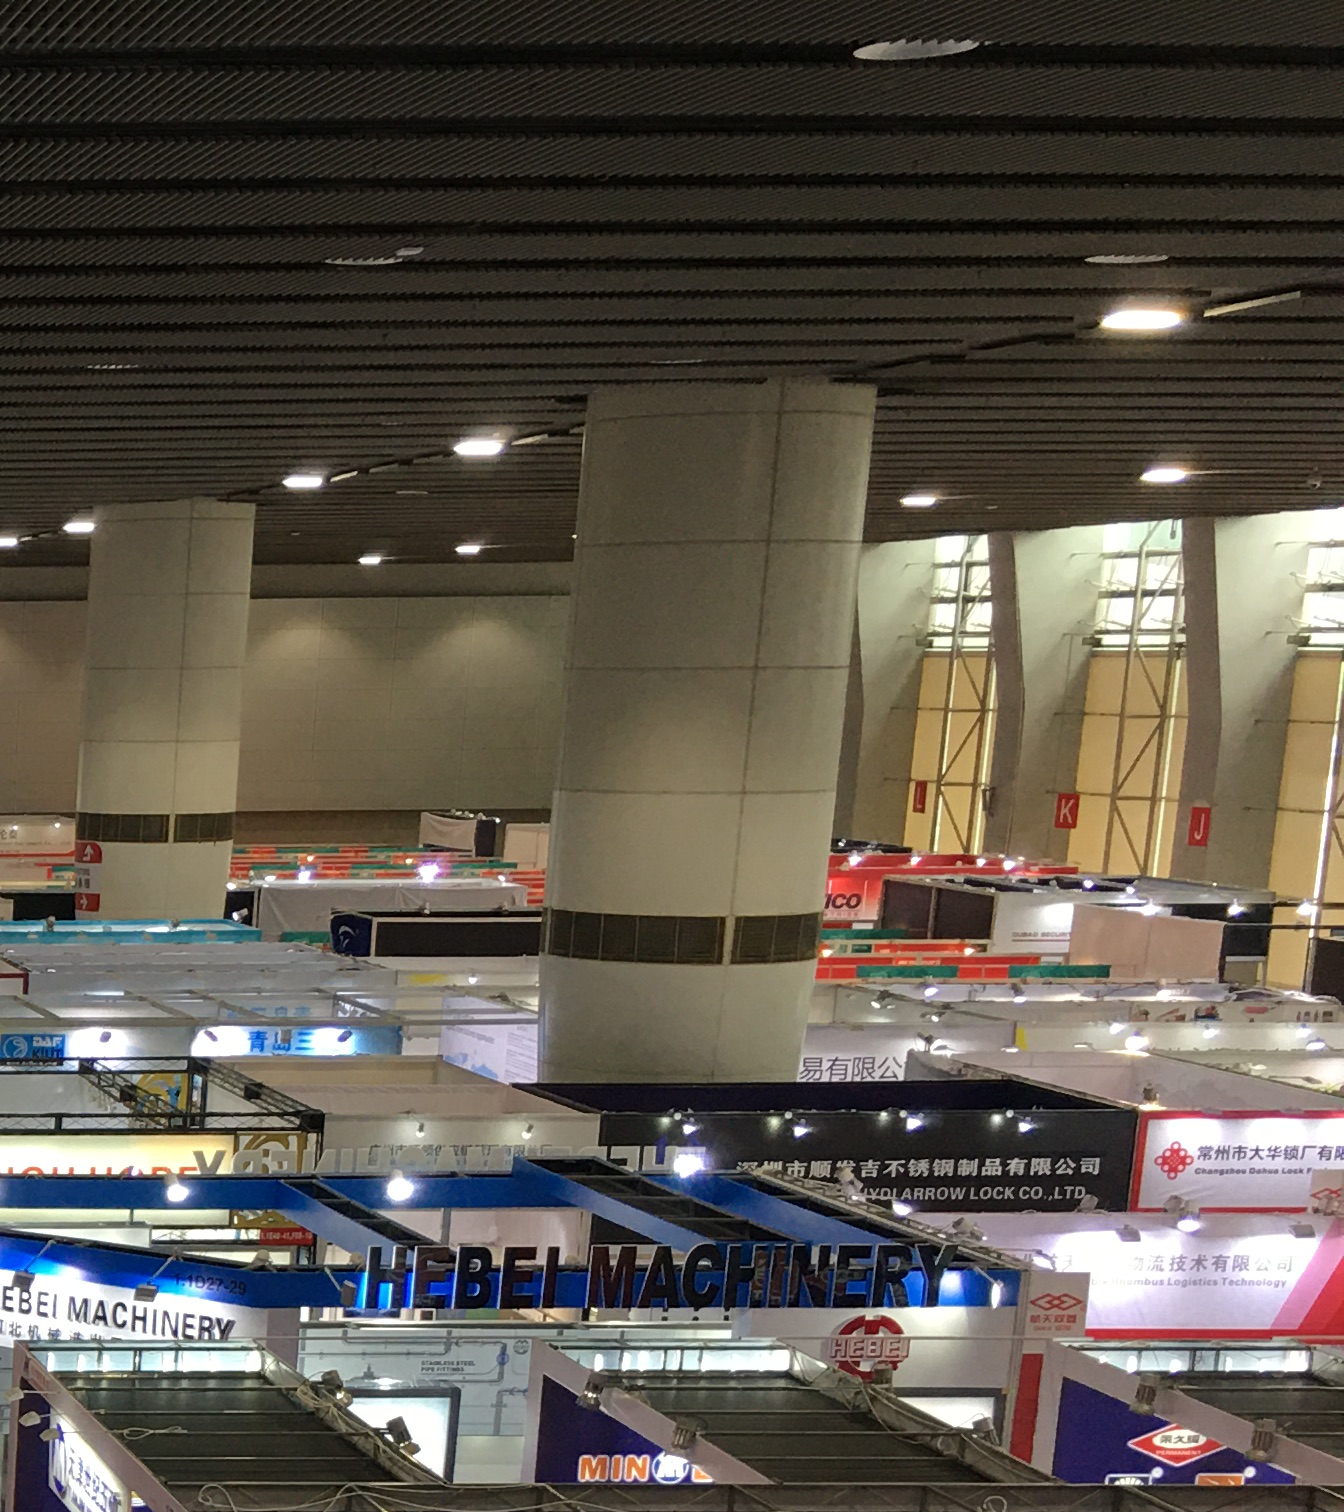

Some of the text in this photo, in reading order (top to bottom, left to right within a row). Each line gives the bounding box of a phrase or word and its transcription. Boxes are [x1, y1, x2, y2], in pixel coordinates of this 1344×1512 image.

[1059, 797, 1075, 824] K
[1192, 812, 1205, 842] J
[969, 1185, 1016, 1201] LOCK
[365, 1242, 960, 1310] HEBEI MACHINERY
[1166, 1276, 1219, 1289] Logistics
[1221, 1277, 1288, 1289] Technology
[67, 1296, 238, 1342] MACHINERY
[830, 1337, 911, 1359] HEBEI
